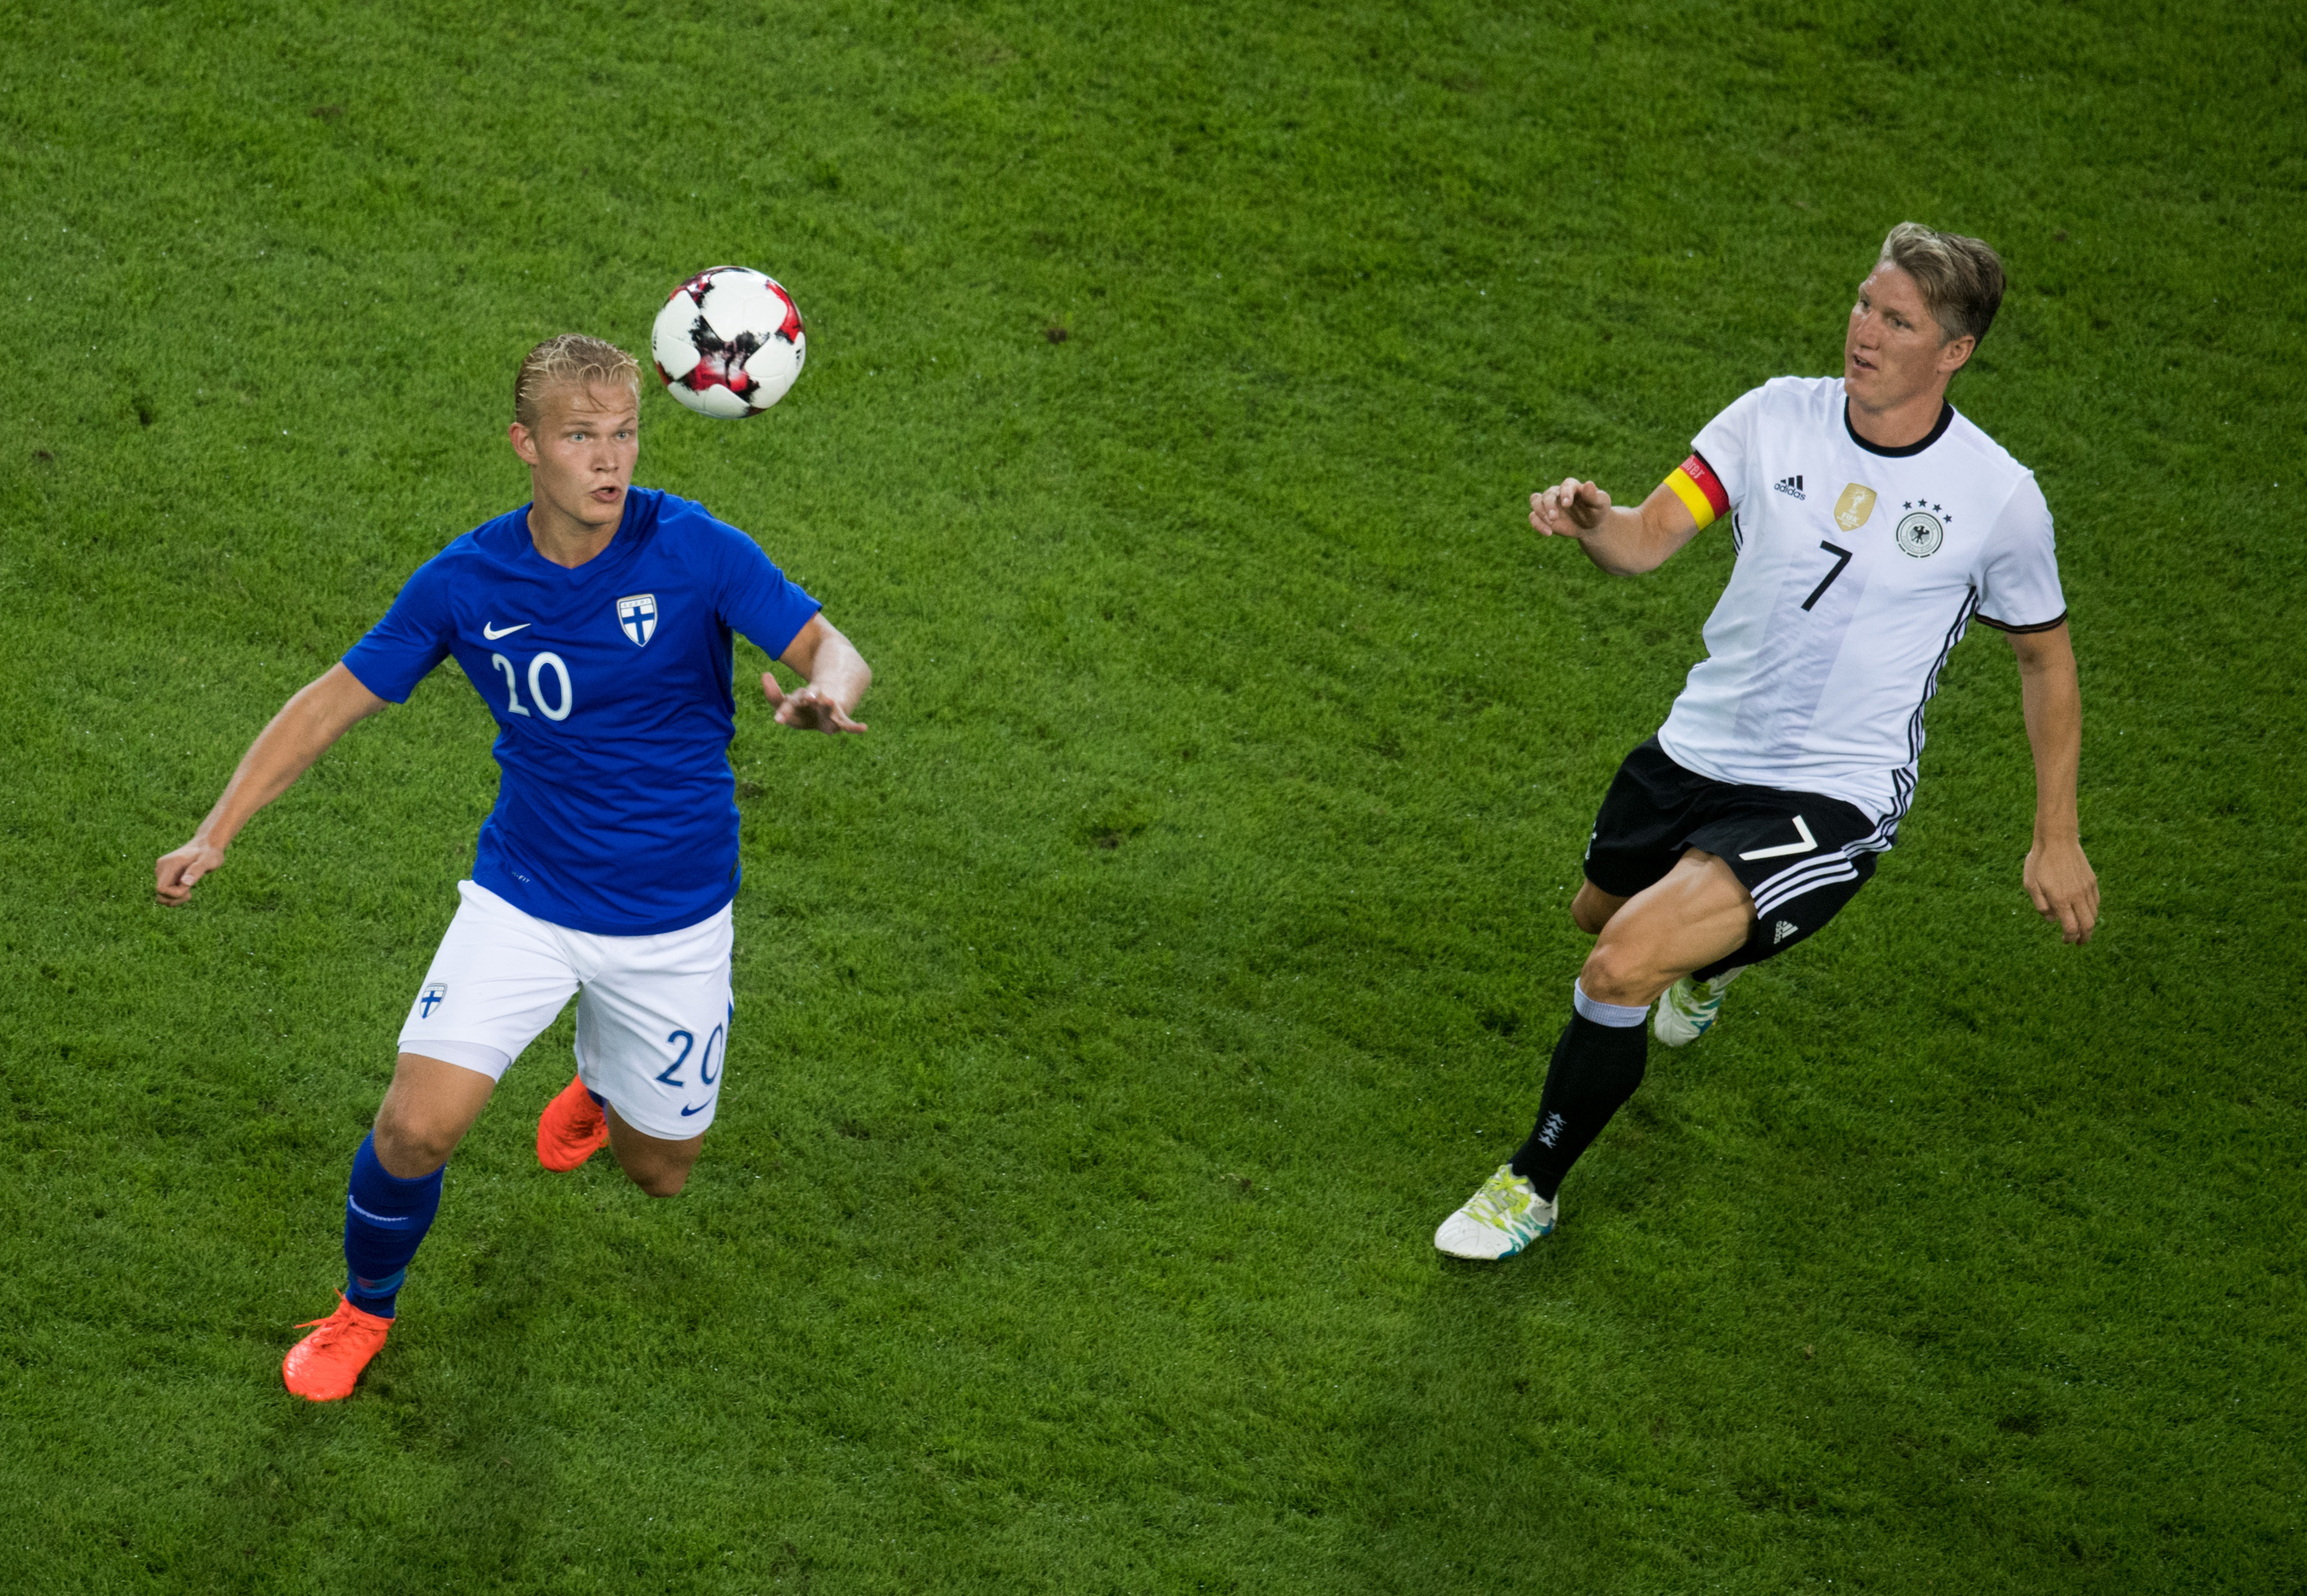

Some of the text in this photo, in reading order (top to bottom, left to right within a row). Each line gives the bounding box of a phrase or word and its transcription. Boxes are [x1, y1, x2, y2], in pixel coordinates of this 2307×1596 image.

[1774, 483, 1806, 501] adidas
[1800, 541, 1852, 611] 7
[492, 652, 572, 721] 20
[1739, 815, 1818, 860] 7
[655, 1022, 723, 1087] 20
